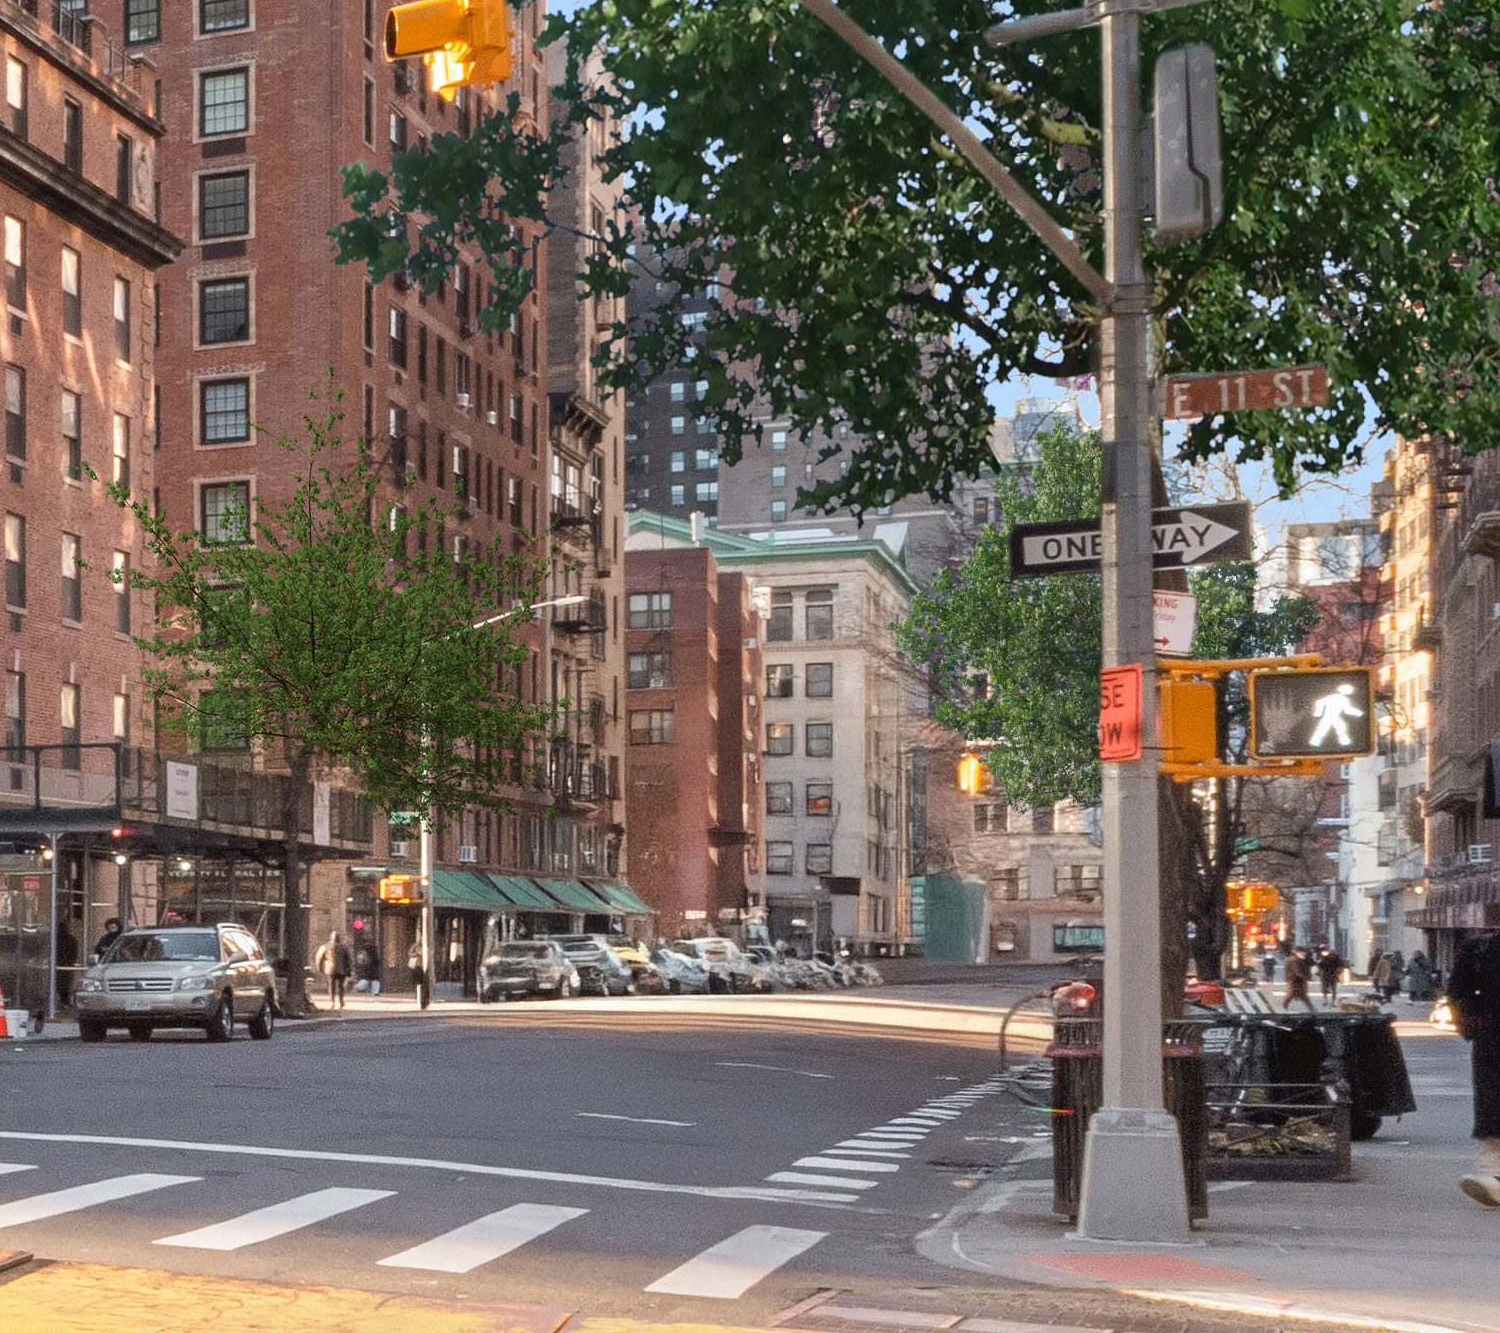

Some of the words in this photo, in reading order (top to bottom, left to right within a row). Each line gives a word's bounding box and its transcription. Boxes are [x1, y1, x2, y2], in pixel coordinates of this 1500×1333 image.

[1173, 383, 1192, 417] E
[1218, 377, 1246, 411] 11
[1273, 370, 1315, 407] ST
[1043, 534, 1102, 561] ONE
